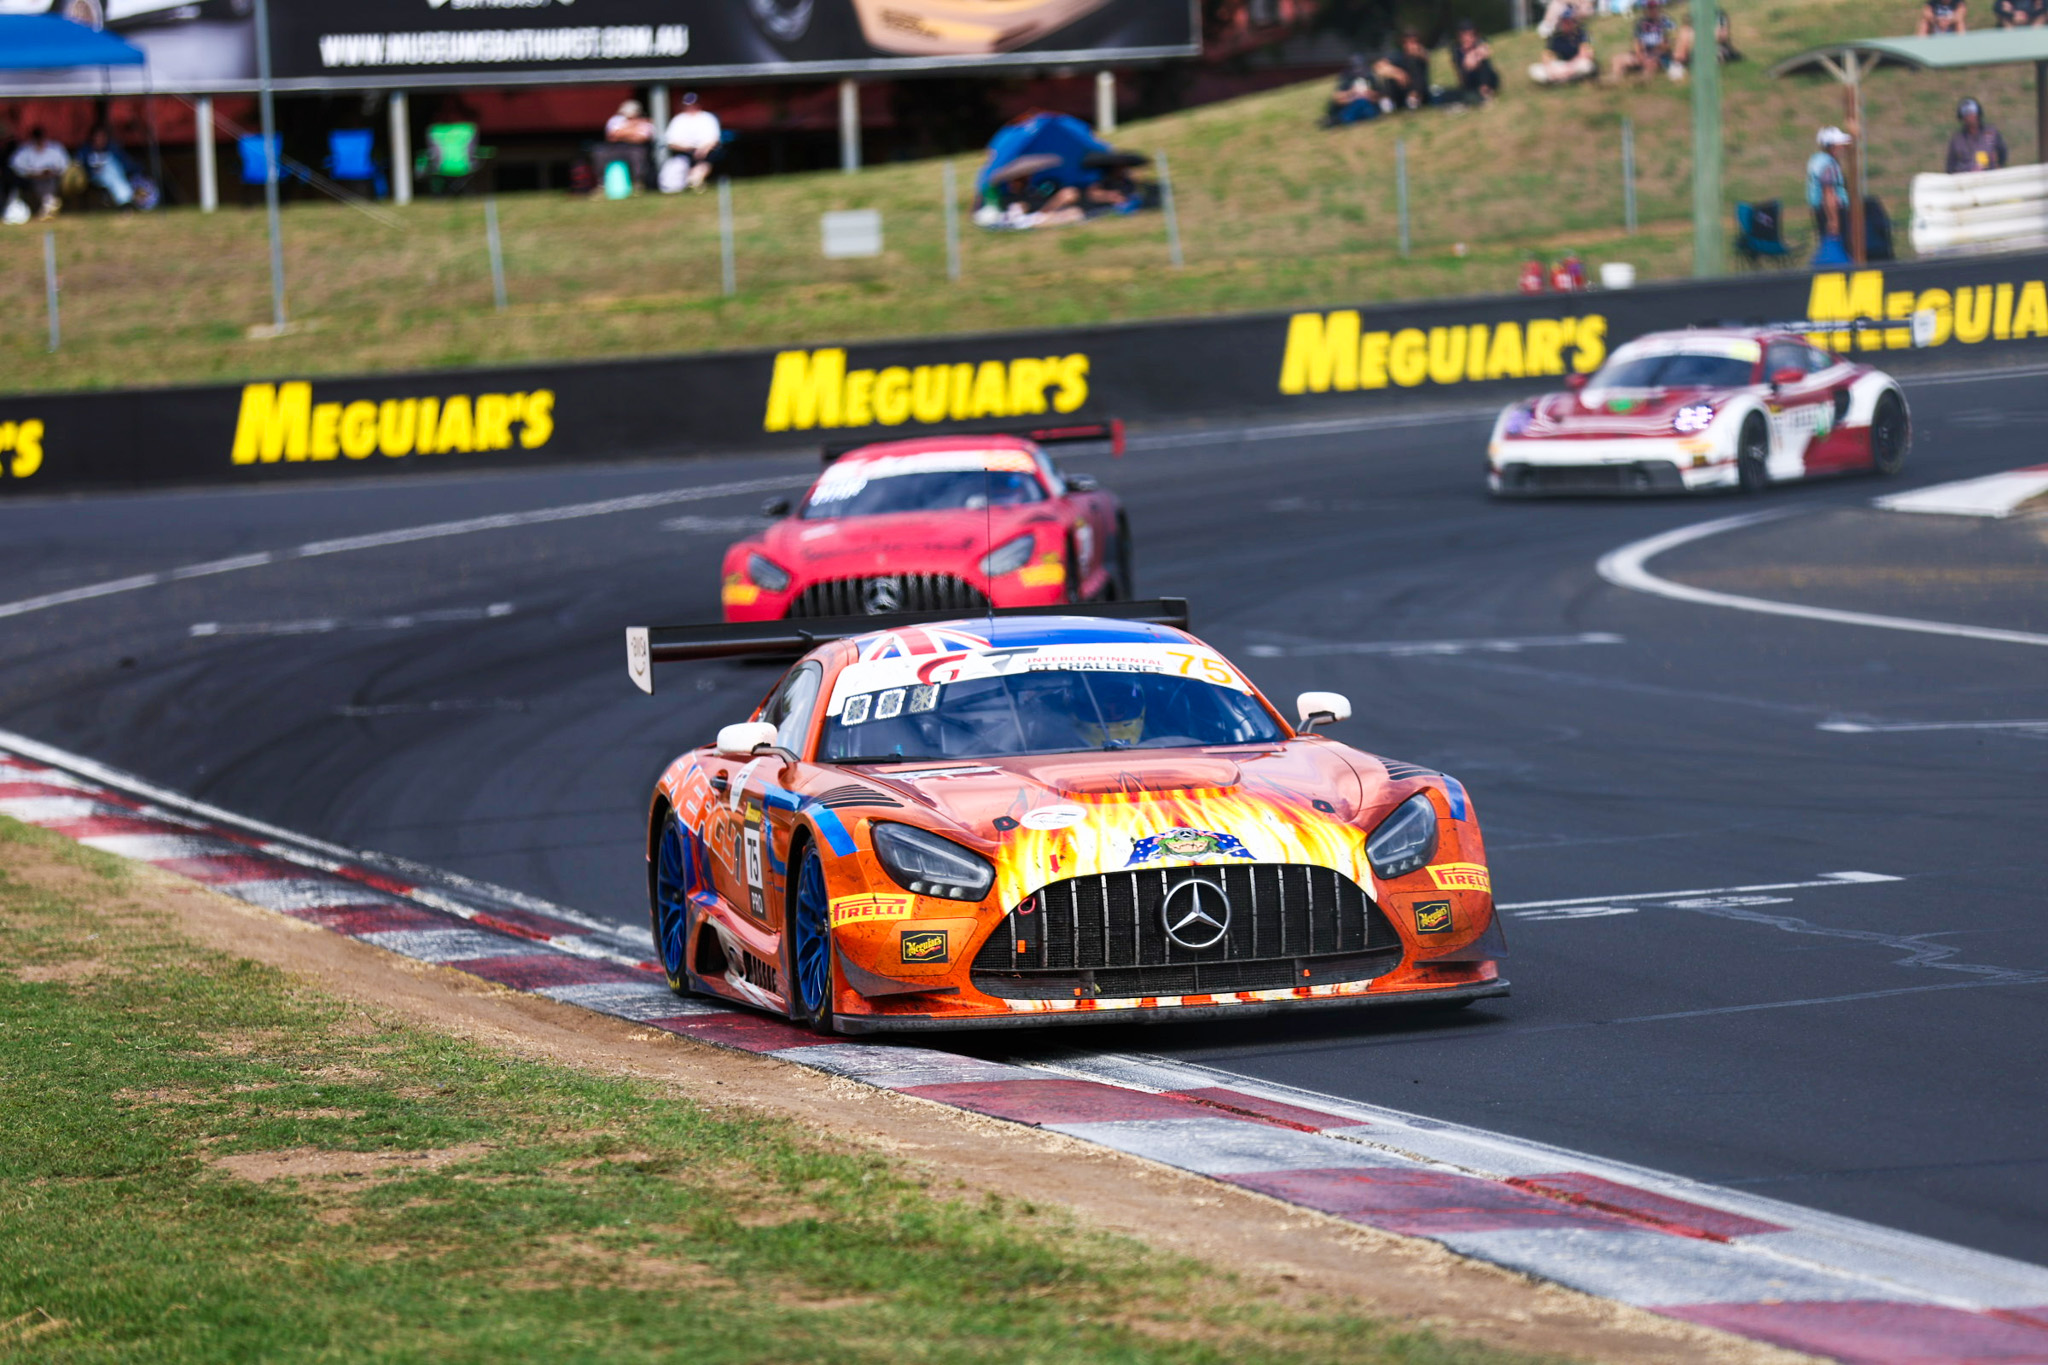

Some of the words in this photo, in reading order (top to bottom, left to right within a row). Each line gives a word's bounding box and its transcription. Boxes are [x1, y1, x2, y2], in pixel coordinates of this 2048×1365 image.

[1805, 269, 2048, 353] MEGUIA
[1028, 655, 1165, 666] INTERCONTINENTAL
[1166, 651, 1233, 684] 75
[747, 838, 759, 882] 75
[1435, 867, 1489, 886] PIRELL
[751, 892, 763, 914] PRO
[834, 898, 907, 921] PIRELLI
[906, 936, 942, 957] Meguiar's
